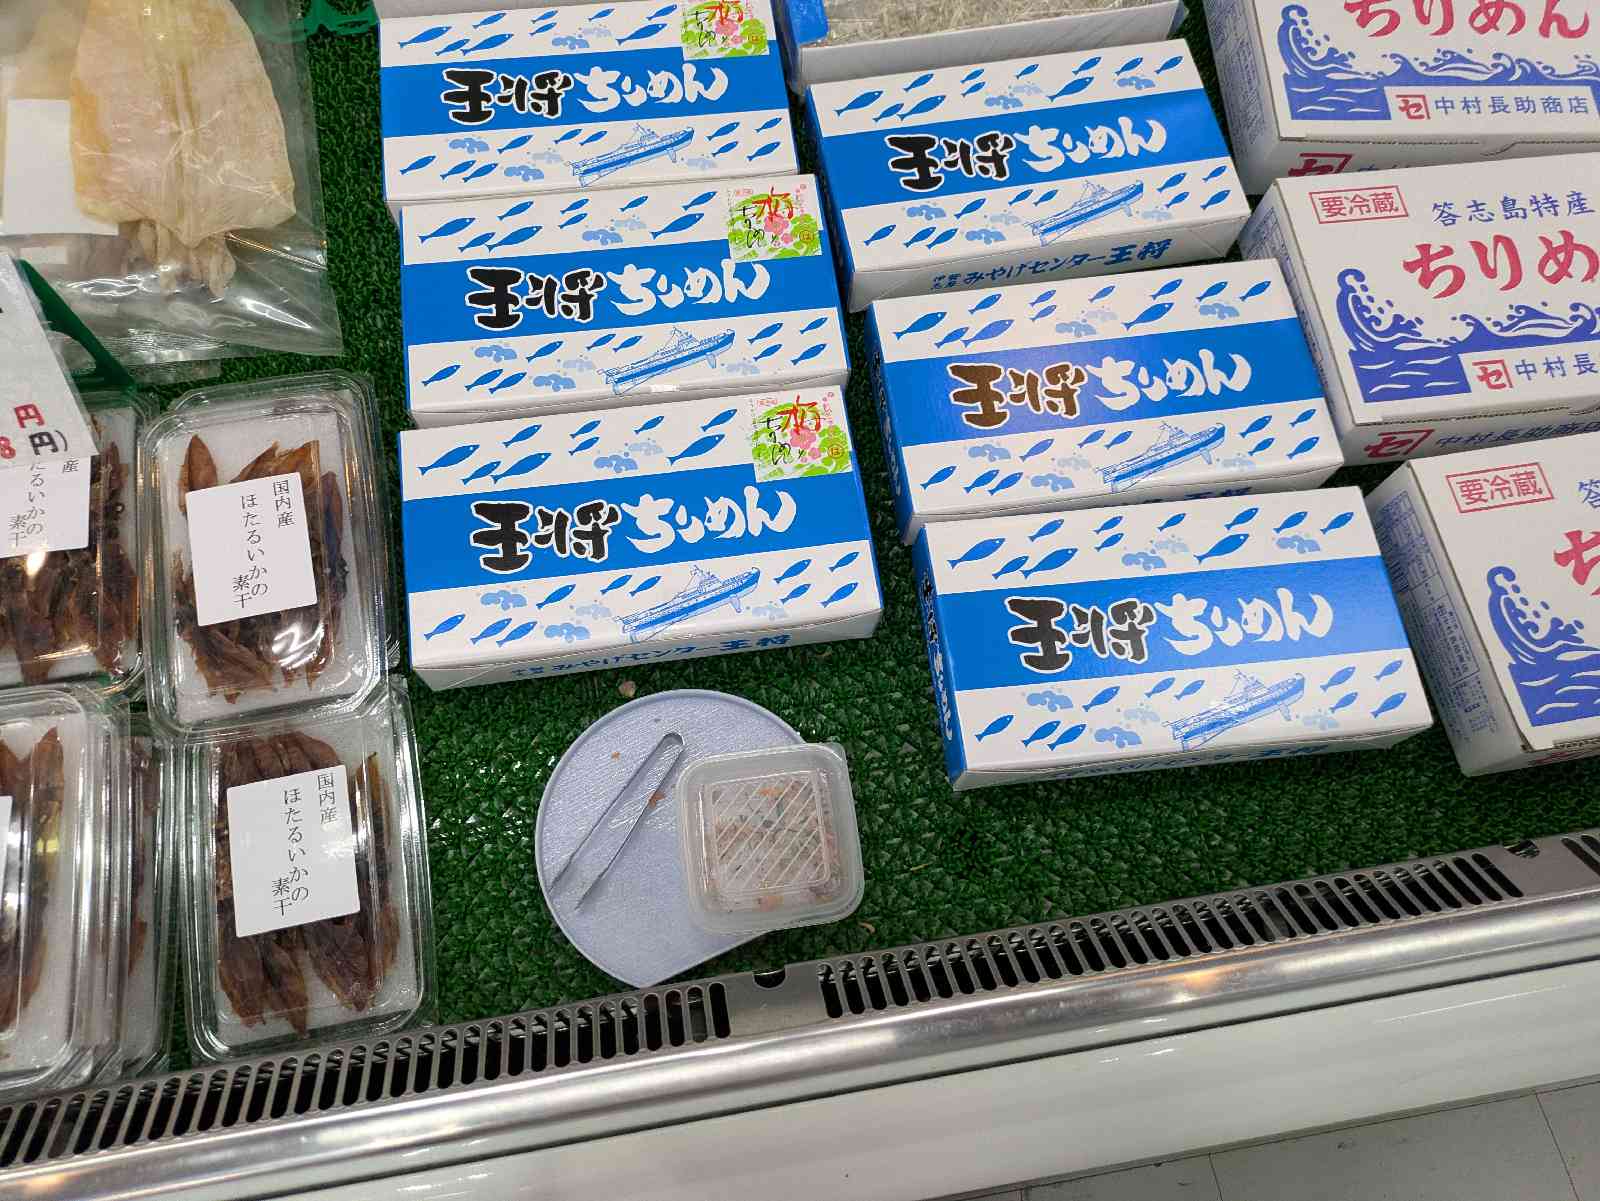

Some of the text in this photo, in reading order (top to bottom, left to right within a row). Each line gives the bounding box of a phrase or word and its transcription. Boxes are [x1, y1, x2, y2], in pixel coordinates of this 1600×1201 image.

[1343, 0, 1591, 39] ちりめん
[1434, 93, 1590, 116] 中村長助商店
[1319, 191, 1400, 218] 要冷蔵
[1431, 190, 1596, 227] 答志島特産
[1402, 229, 1600, 300] ちりめ
[14, 403, 46, 429] 円
[272, 479, 296, 529] 国内産
[1455, 470, 1543, 505] 要冷蔵
[239, 493, 269, 597] ほたるいかの
[232, 573, 253, 609] 素干
[317, 772, 338, 826] 国内産
[282, 787, 310, 903] ほたるいかの
[271, 876, 293, 917] 素干
